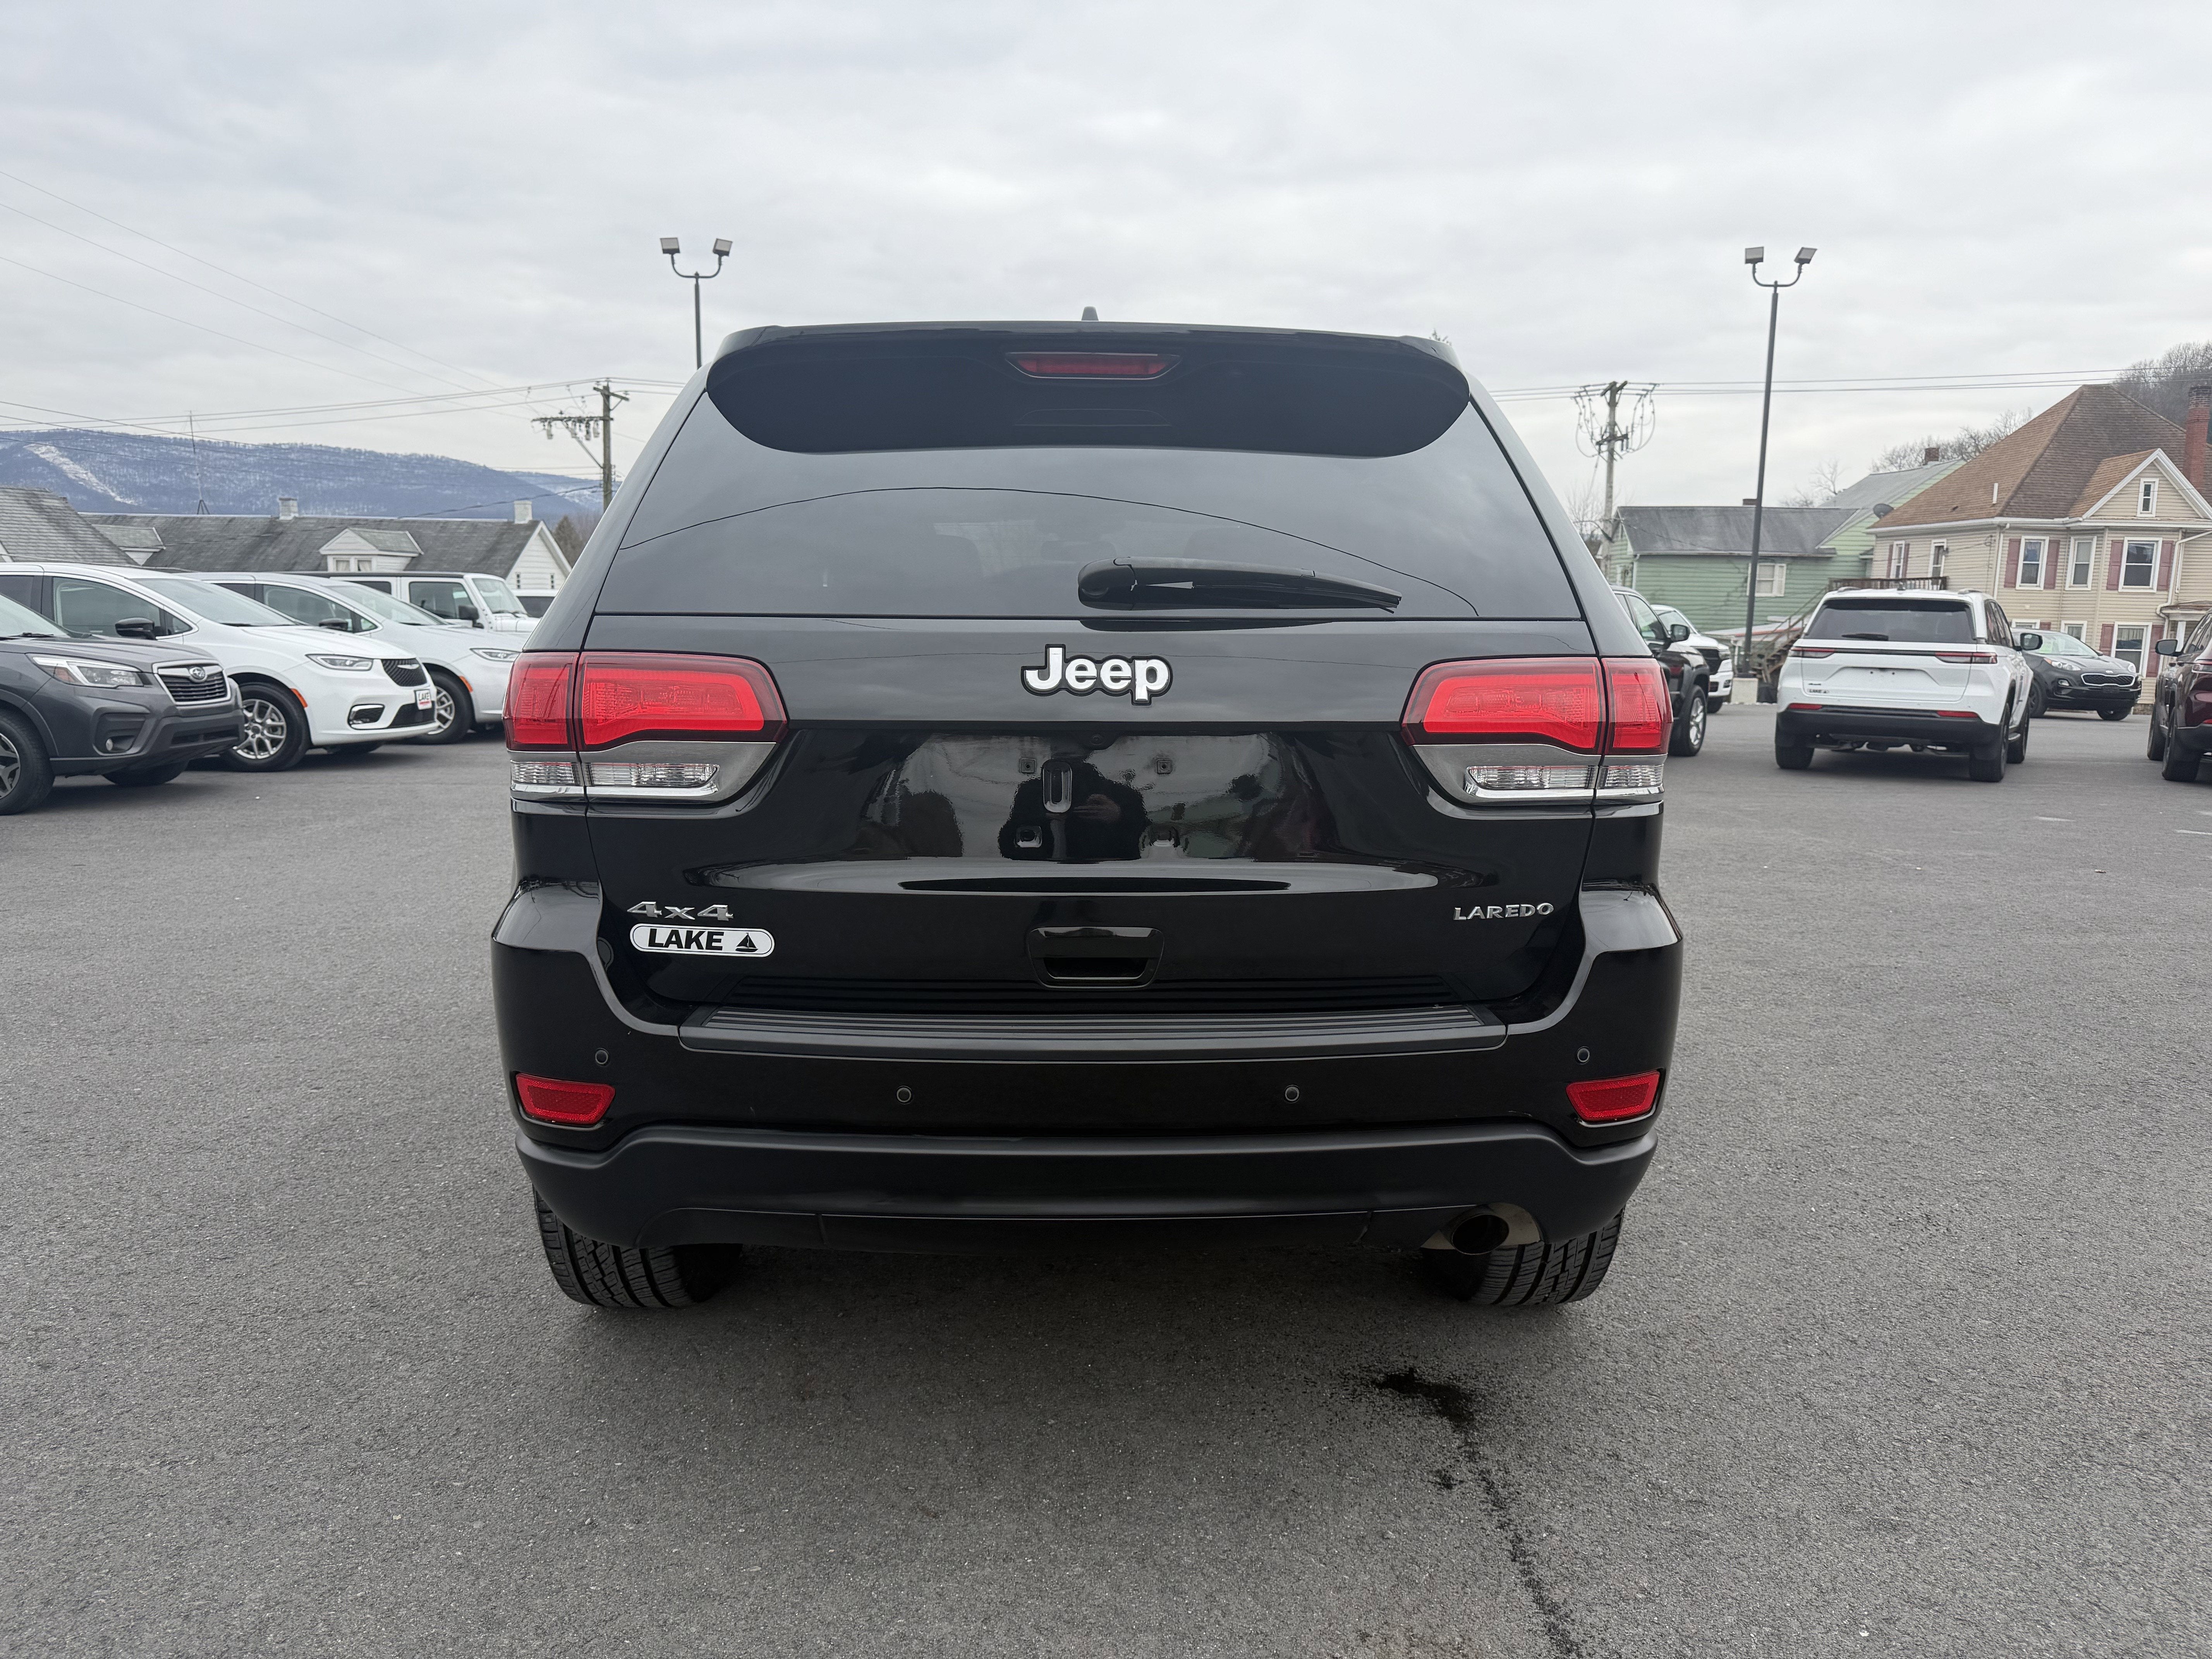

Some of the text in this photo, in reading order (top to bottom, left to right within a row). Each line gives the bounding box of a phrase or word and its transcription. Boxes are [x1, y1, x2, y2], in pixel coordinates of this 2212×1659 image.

[1024, 647, 1170, 702] Jeep
[627, 901, 734, 921] 4x4
[1453, 902, 1554, 921] LAREDO
[647, 928, 724, 951] LAKE
